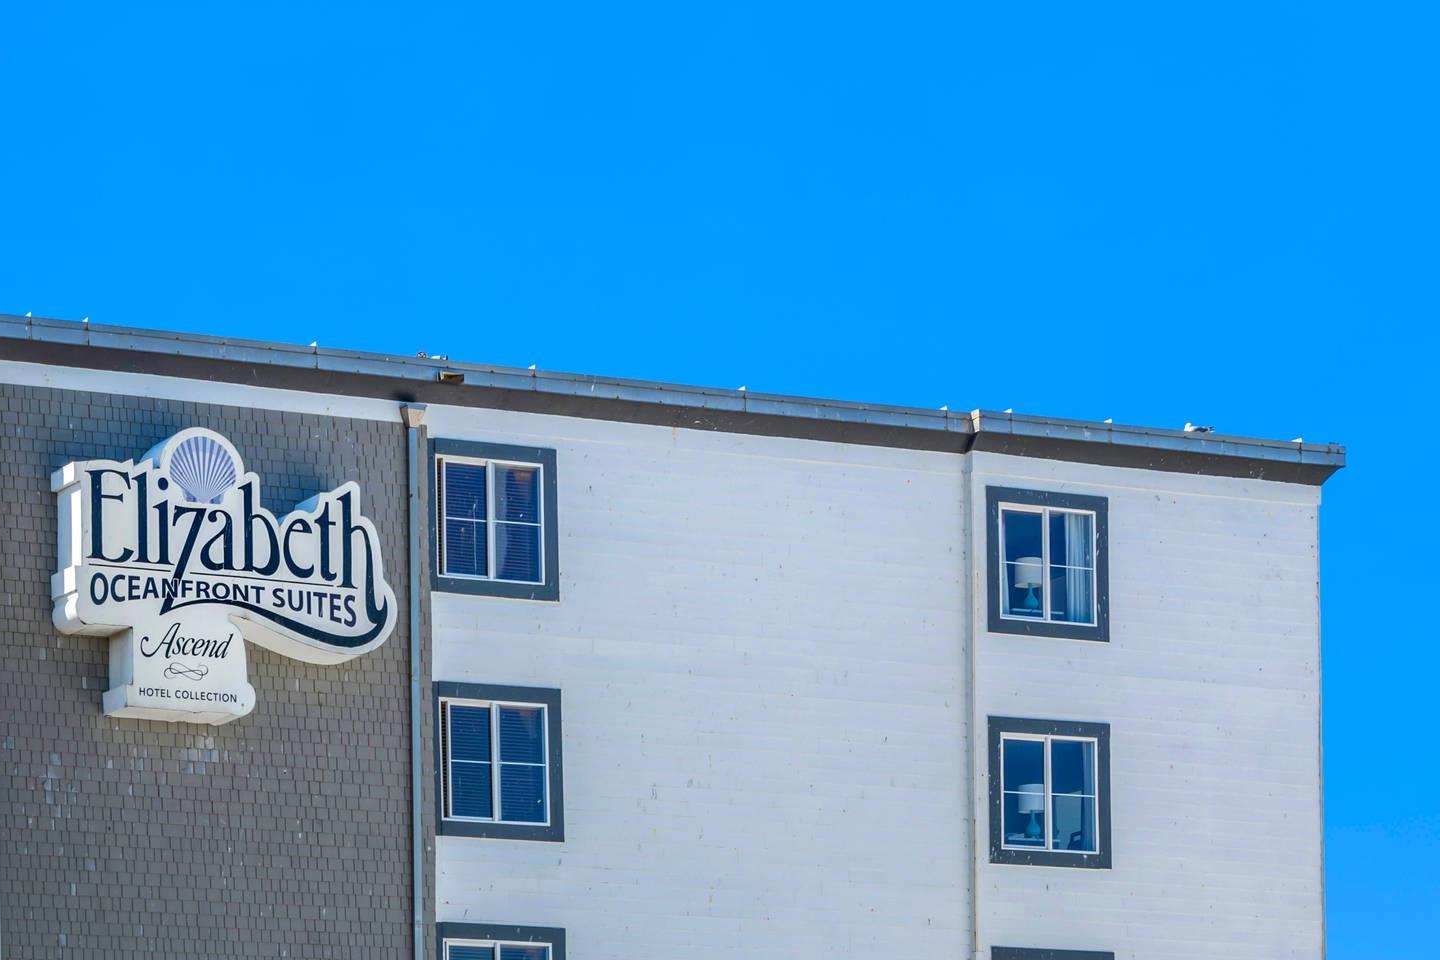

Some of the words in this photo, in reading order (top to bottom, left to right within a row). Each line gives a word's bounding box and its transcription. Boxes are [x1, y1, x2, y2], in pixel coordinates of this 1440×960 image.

[85, 469, 388, 628] Elizabeth
[90, 572, 265, 608] OCEANFRONT
[272, 588, 358, 628] SUITES
[140, 622, 234, 659] Ascend
[139, 687, 171, 699] HOTEL
[175, 689, 238, 703] COLLECTION
